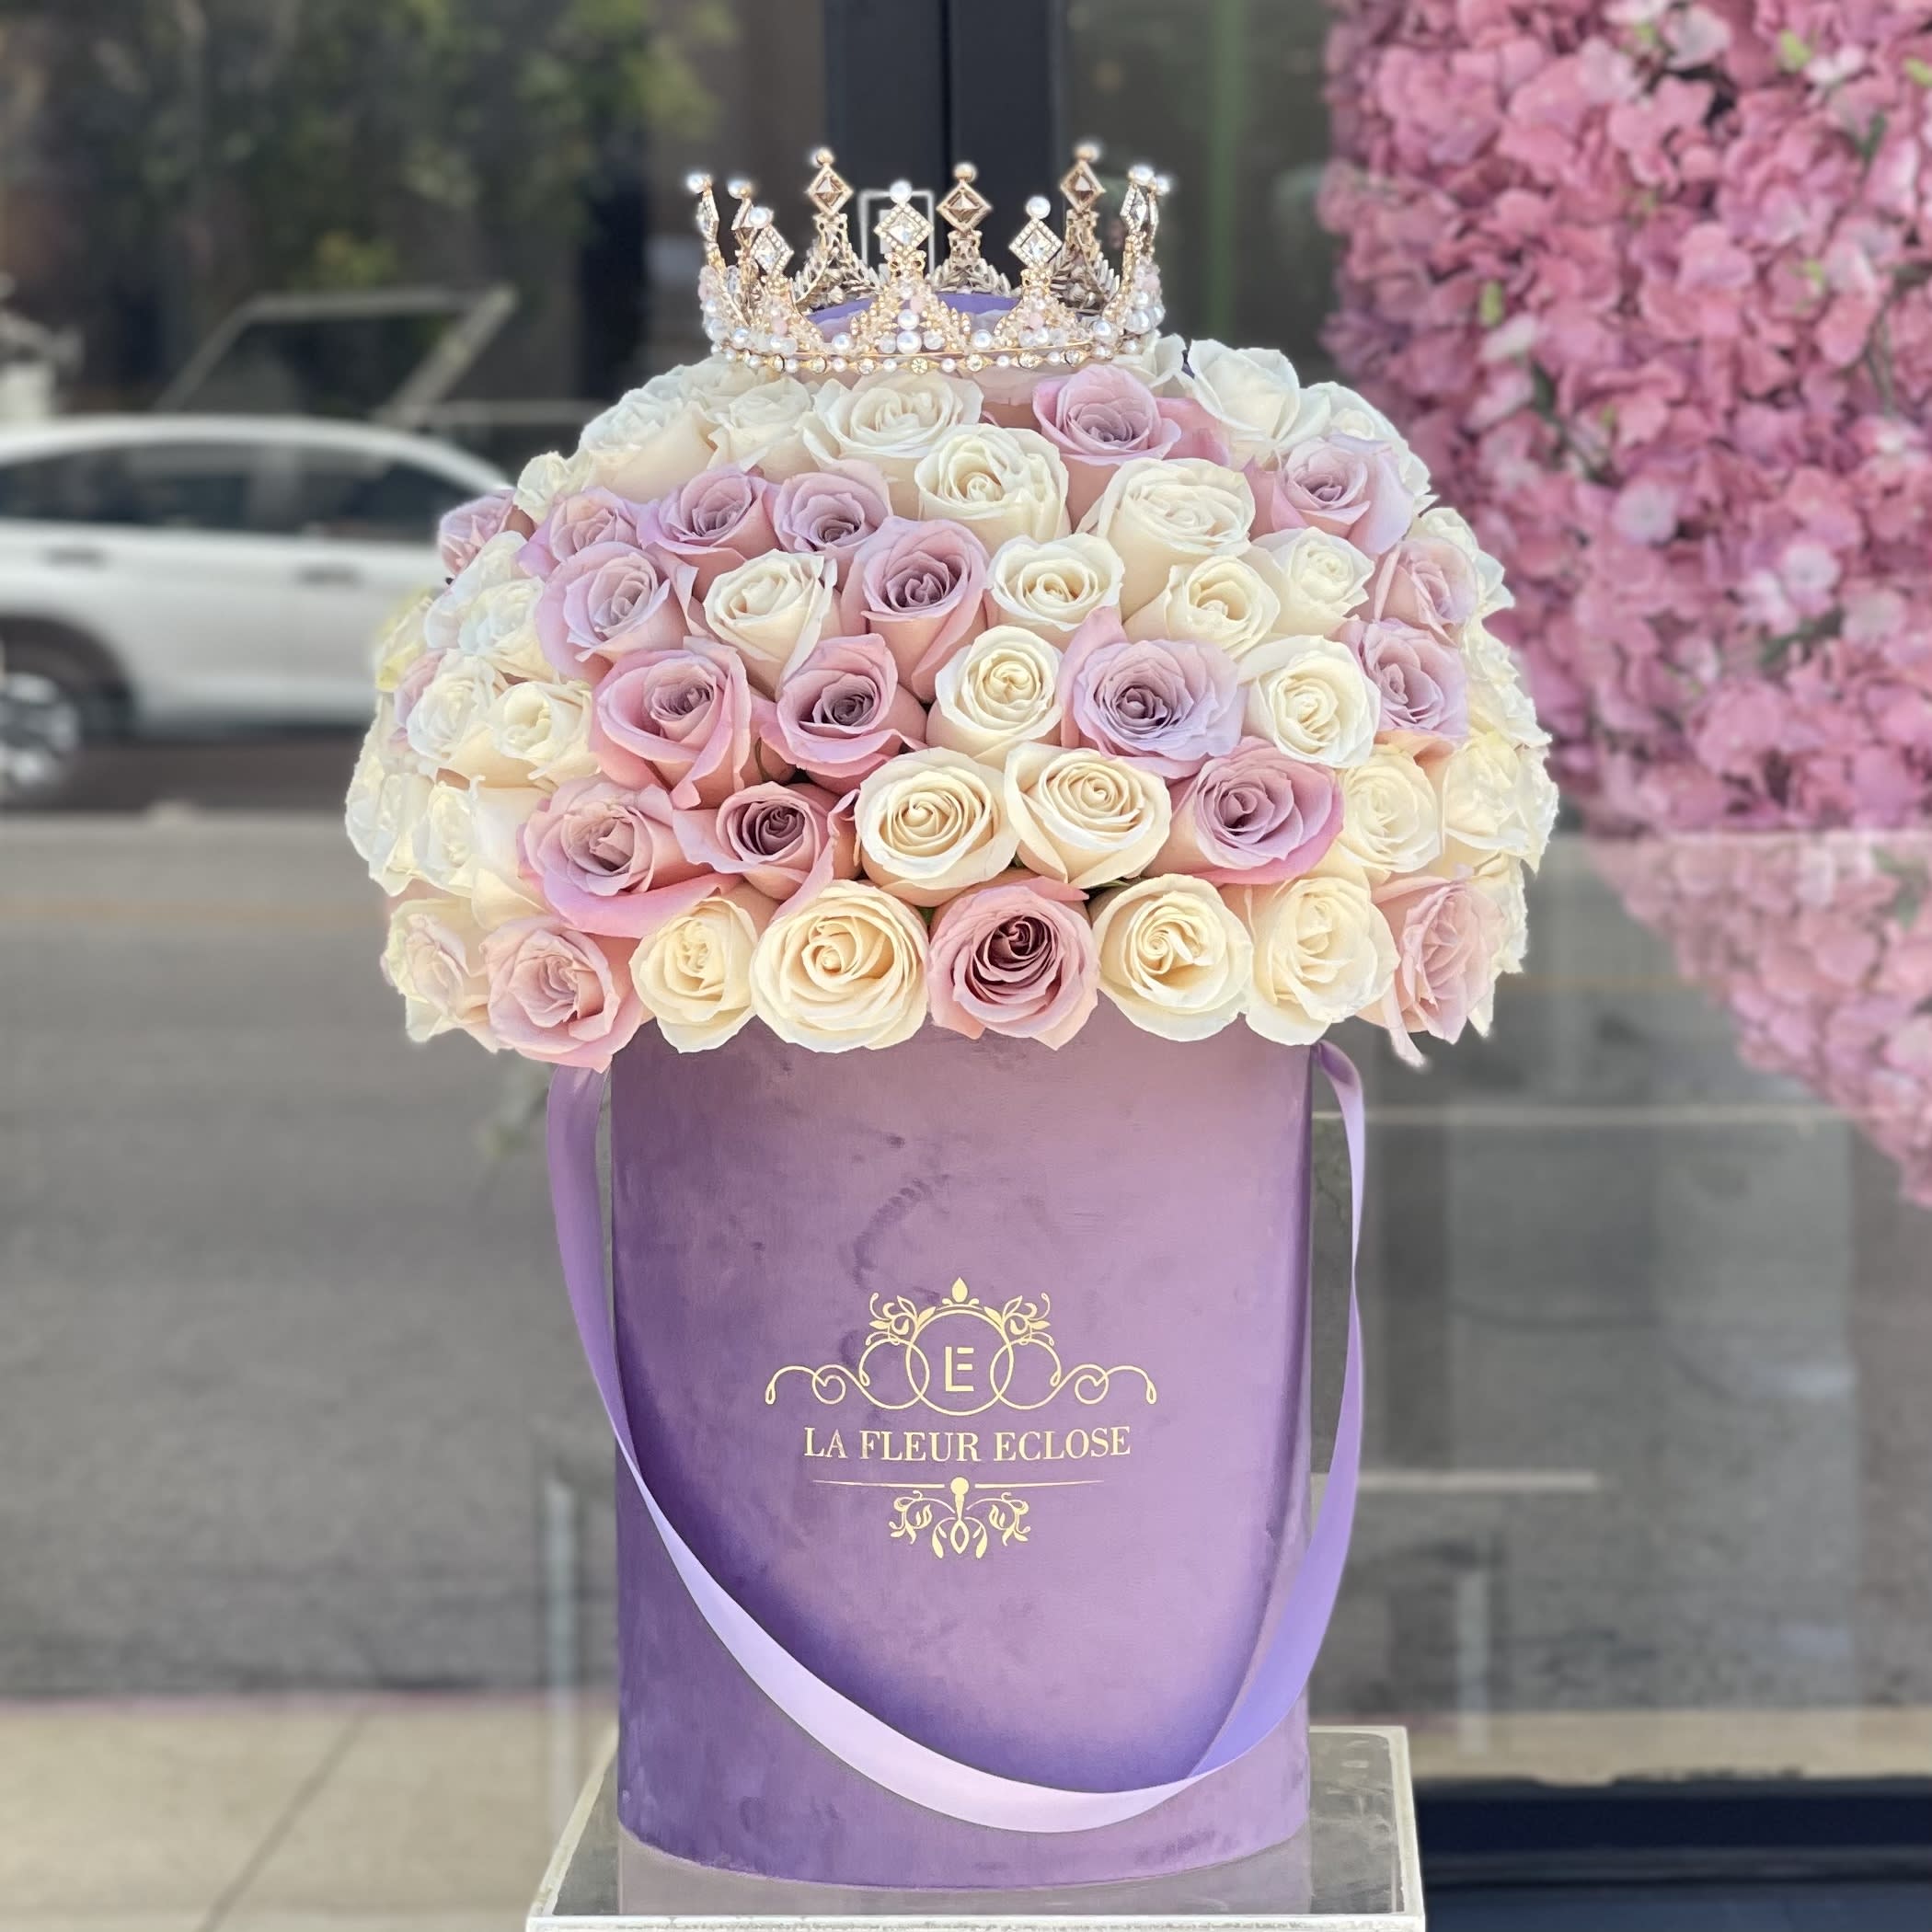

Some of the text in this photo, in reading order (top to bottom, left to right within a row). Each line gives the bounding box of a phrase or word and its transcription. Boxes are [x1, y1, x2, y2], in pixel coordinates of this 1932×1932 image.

[803, 1426, 1132, 1463] LA FLEUR ECLOSE
